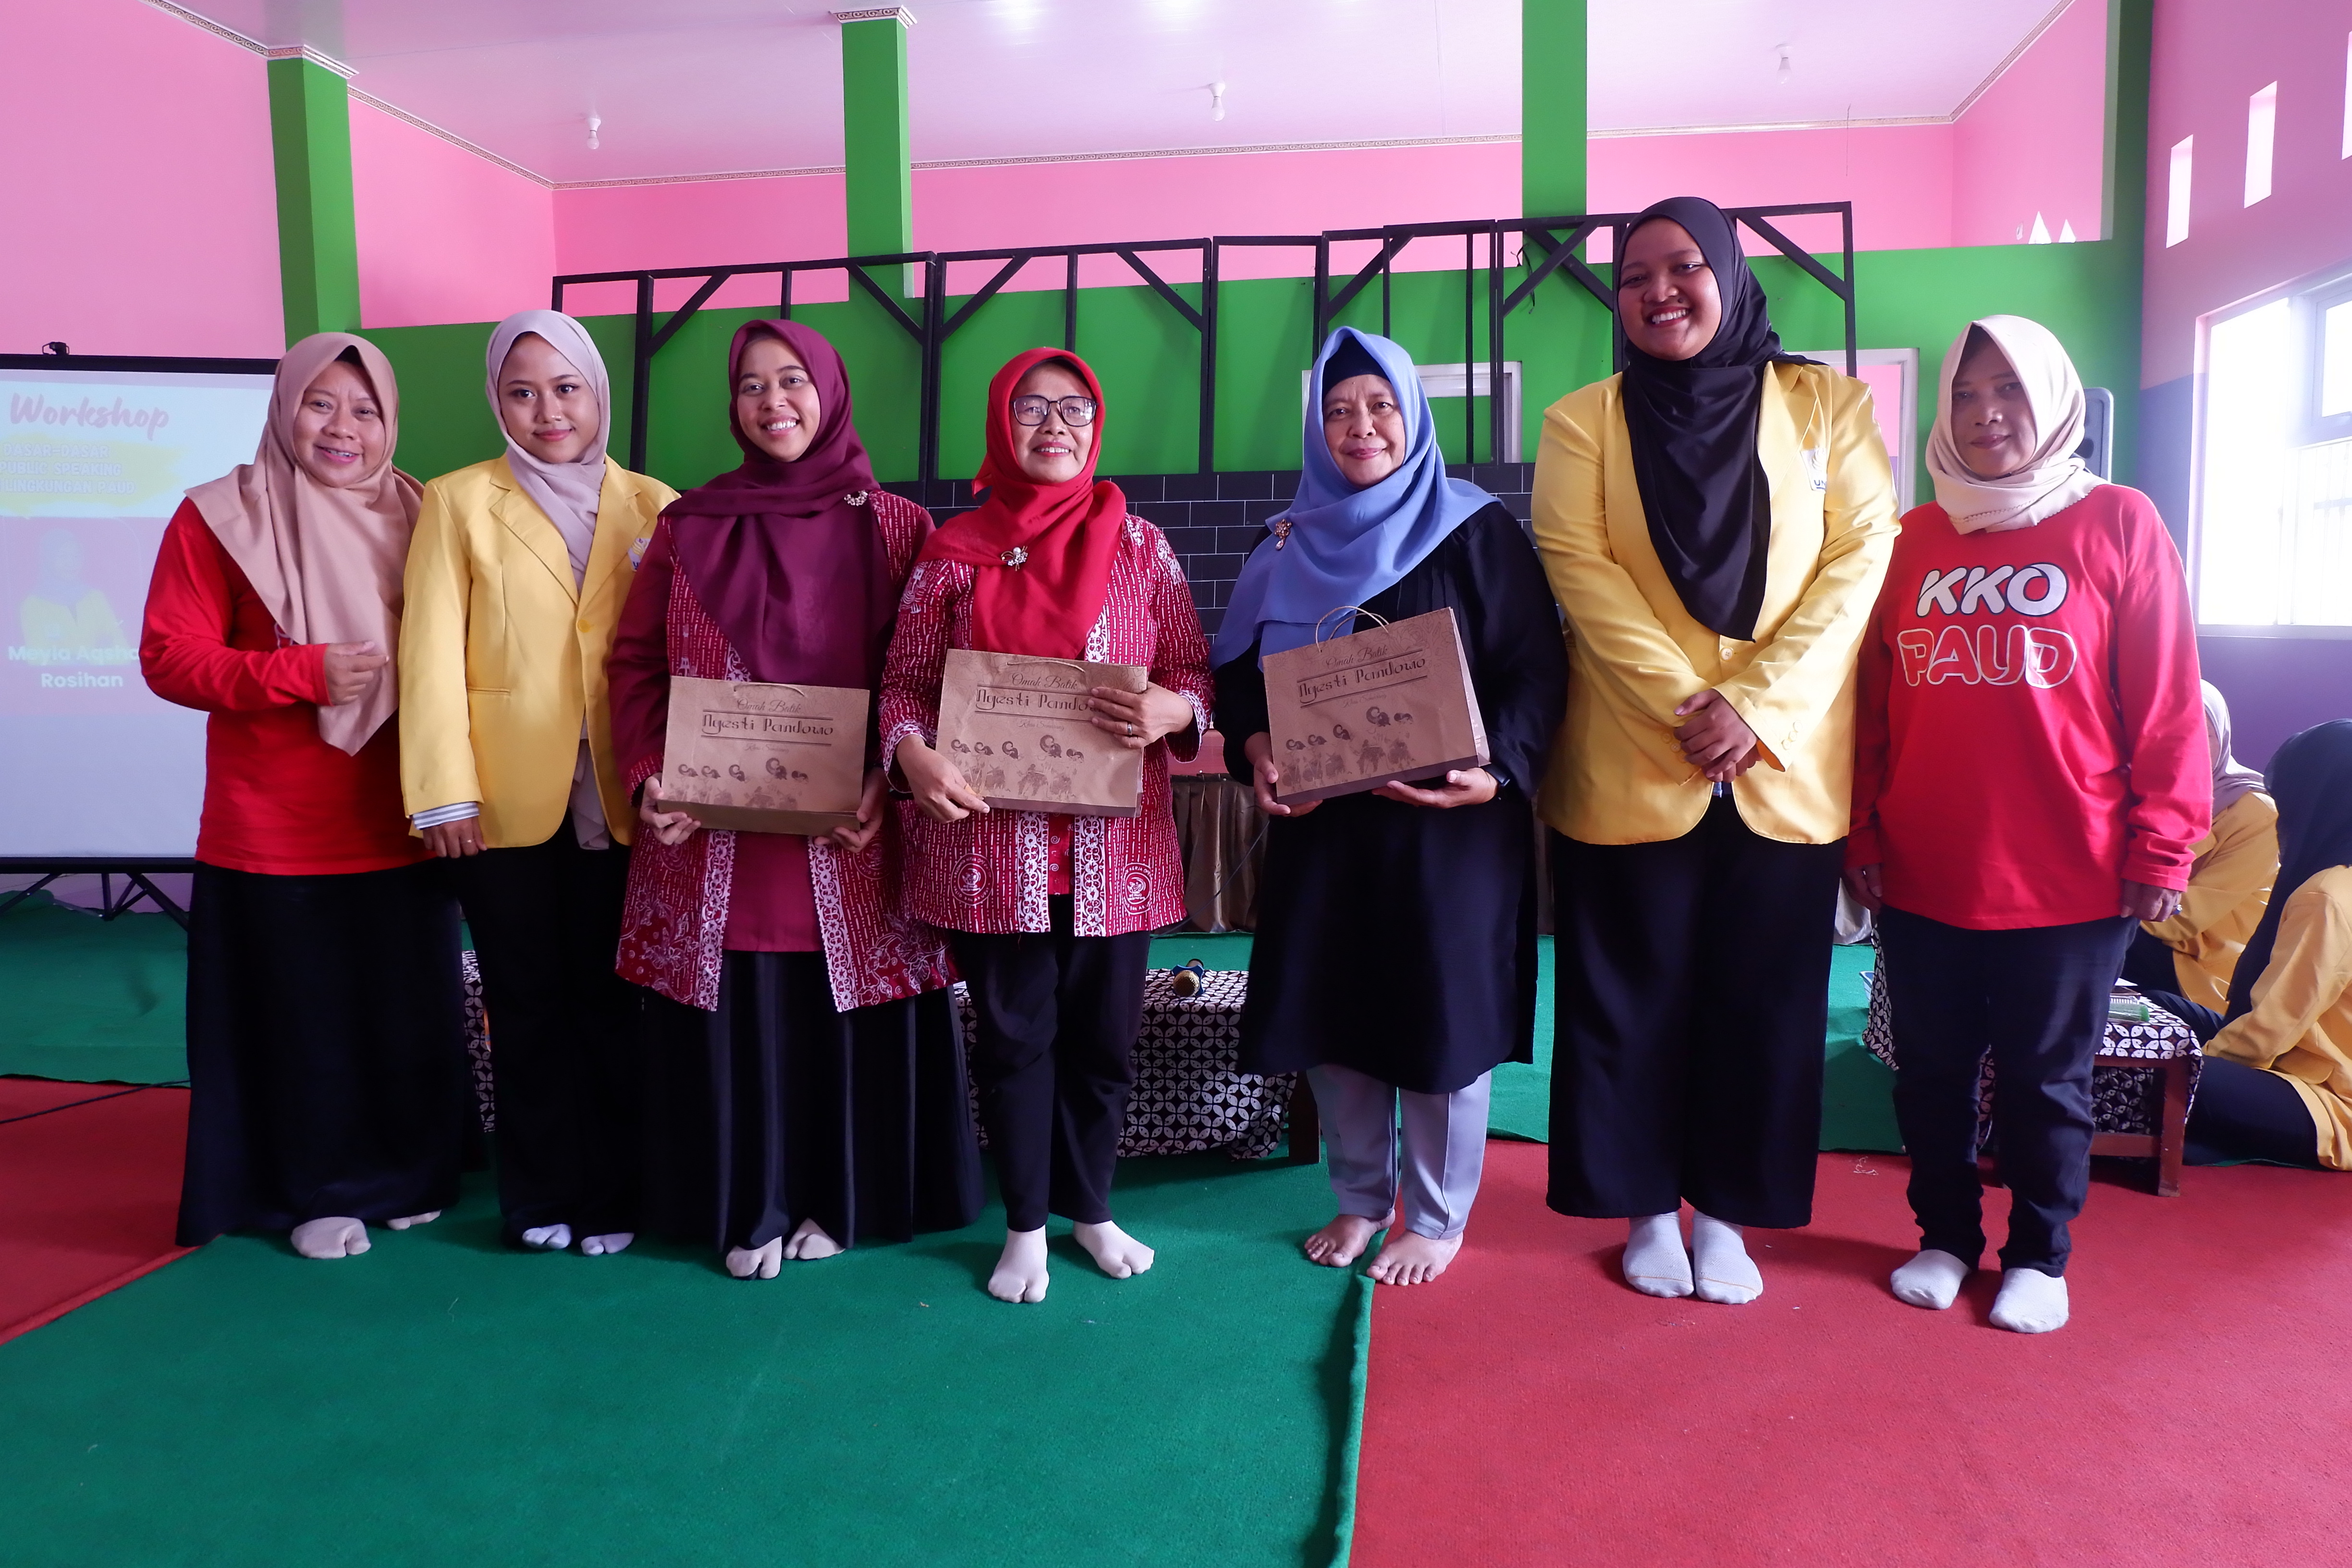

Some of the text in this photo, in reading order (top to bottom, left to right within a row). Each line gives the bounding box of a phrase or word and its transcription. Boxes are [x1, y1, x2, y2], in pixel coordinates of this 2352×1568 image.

[10, 392, 170, 441] Workshop
[3, 442, 110, 458] DASAR-DASAR
[0, 460, 122, 477] PUBLIC SPEAKING
[4, 478, 93, 494] LINGKUNGAN
[97, 480, 136, 495] PAUD
[1916, 562, 2069, 618] KKO
[1326, 645, 1388, 669] Omah Batik
[1897, 625, 2077, 689] PAUD
[41, 671, 124, 687] Rosihan
[1012, 673, 1078, 689] Omah Batik
[736, 698, 802, 713] Omah Batik
